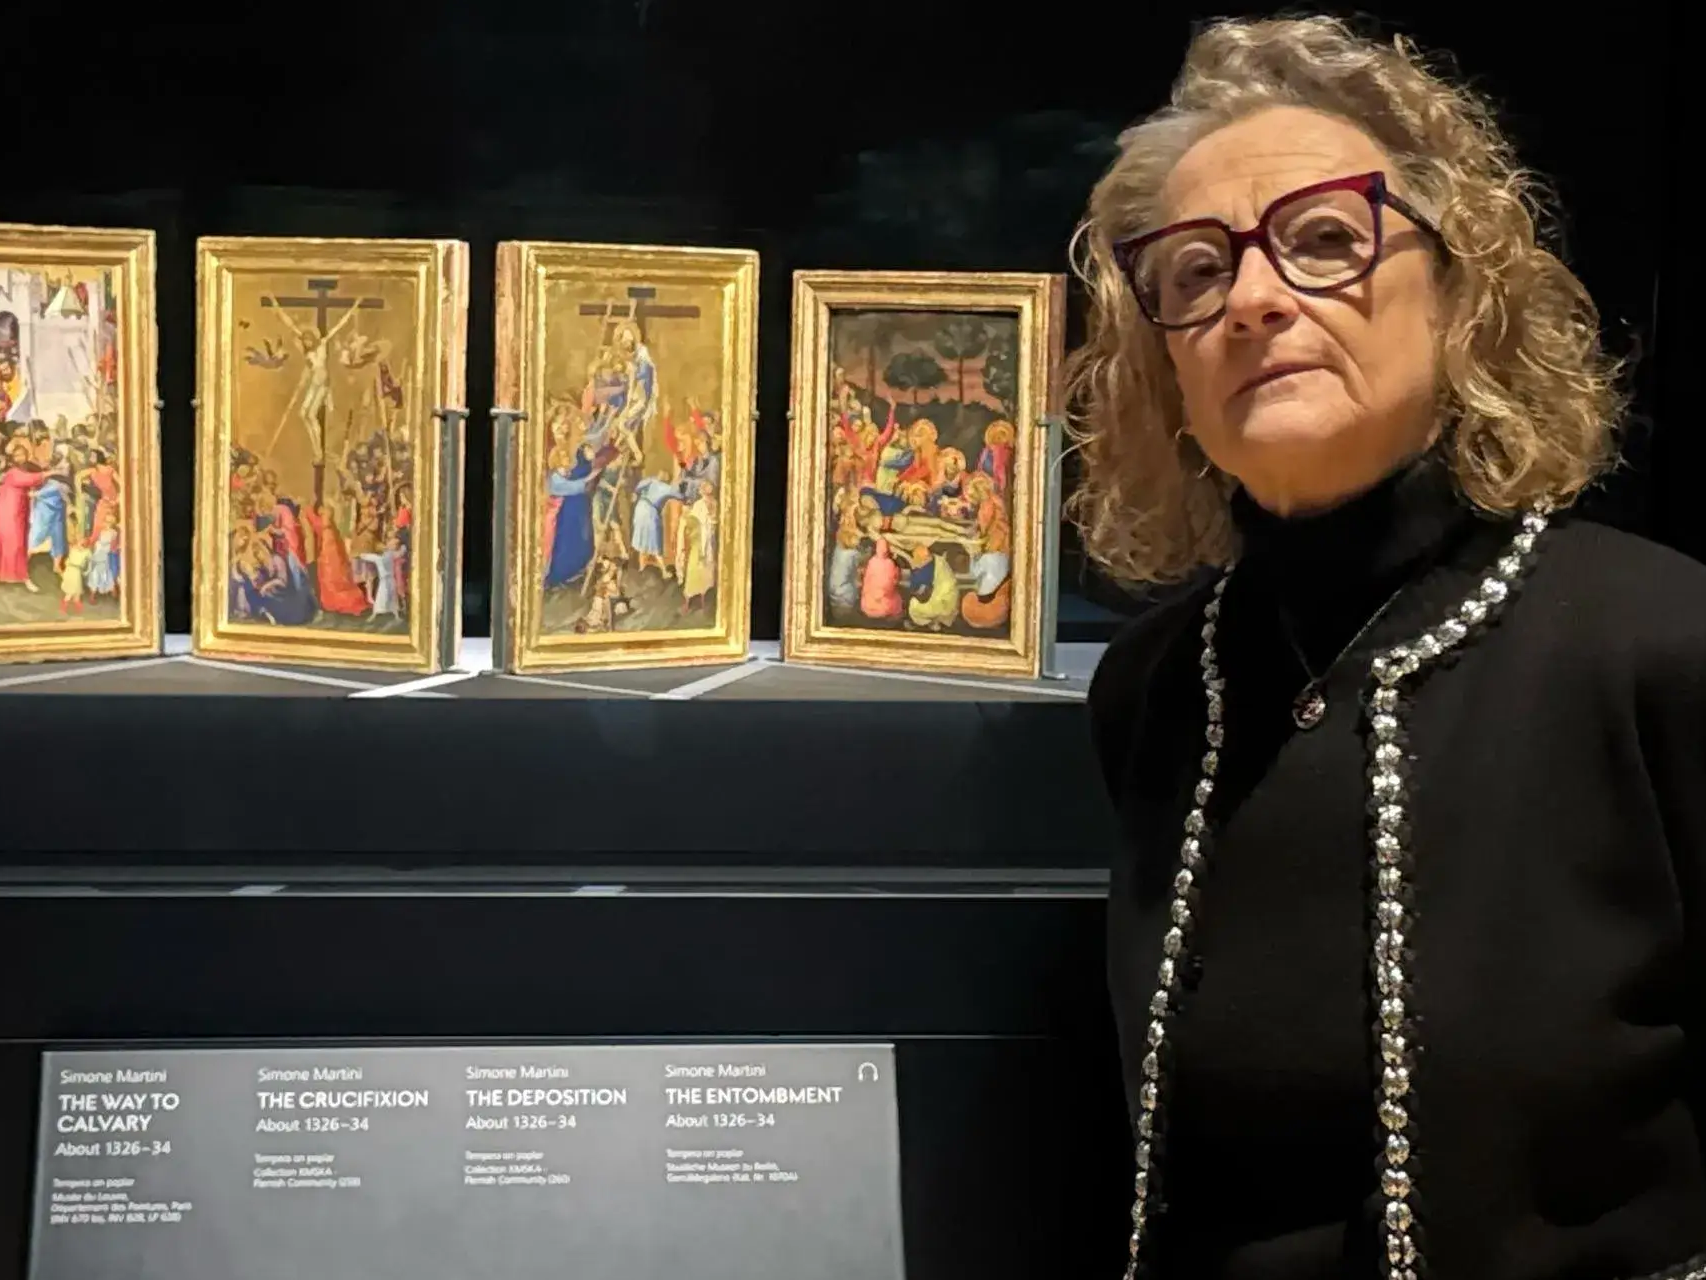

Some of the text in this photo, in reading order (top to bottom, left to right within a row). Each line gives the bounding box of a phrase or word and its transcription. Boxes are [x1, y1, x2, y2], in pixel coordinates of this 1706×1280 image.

[61, 1070, 166, 1084] Simone Martini
[258, 1067, 362, 1082] Simone Martini
[466, 1066, 568, 1079] Simone Martini
[665, 1064, 765, 1077] Simone Martini
[59, 1093, 179, 1111] THE WAY TO
[258, 1090, 428, 1108] THE CRUCIFIXION
[466, 1089, 626, 1106] THE DEPOSITION
[666, 1087, 842, 1104] THE ENTOMBMENT
[57, 1115, 152, 1132] CALVARY
[256, 1118, 300, 1132] About
[466, 1116, 508, 1129] About
[666, 1114, 708, 1127] About
[55, 1143, 100, 1156] About
